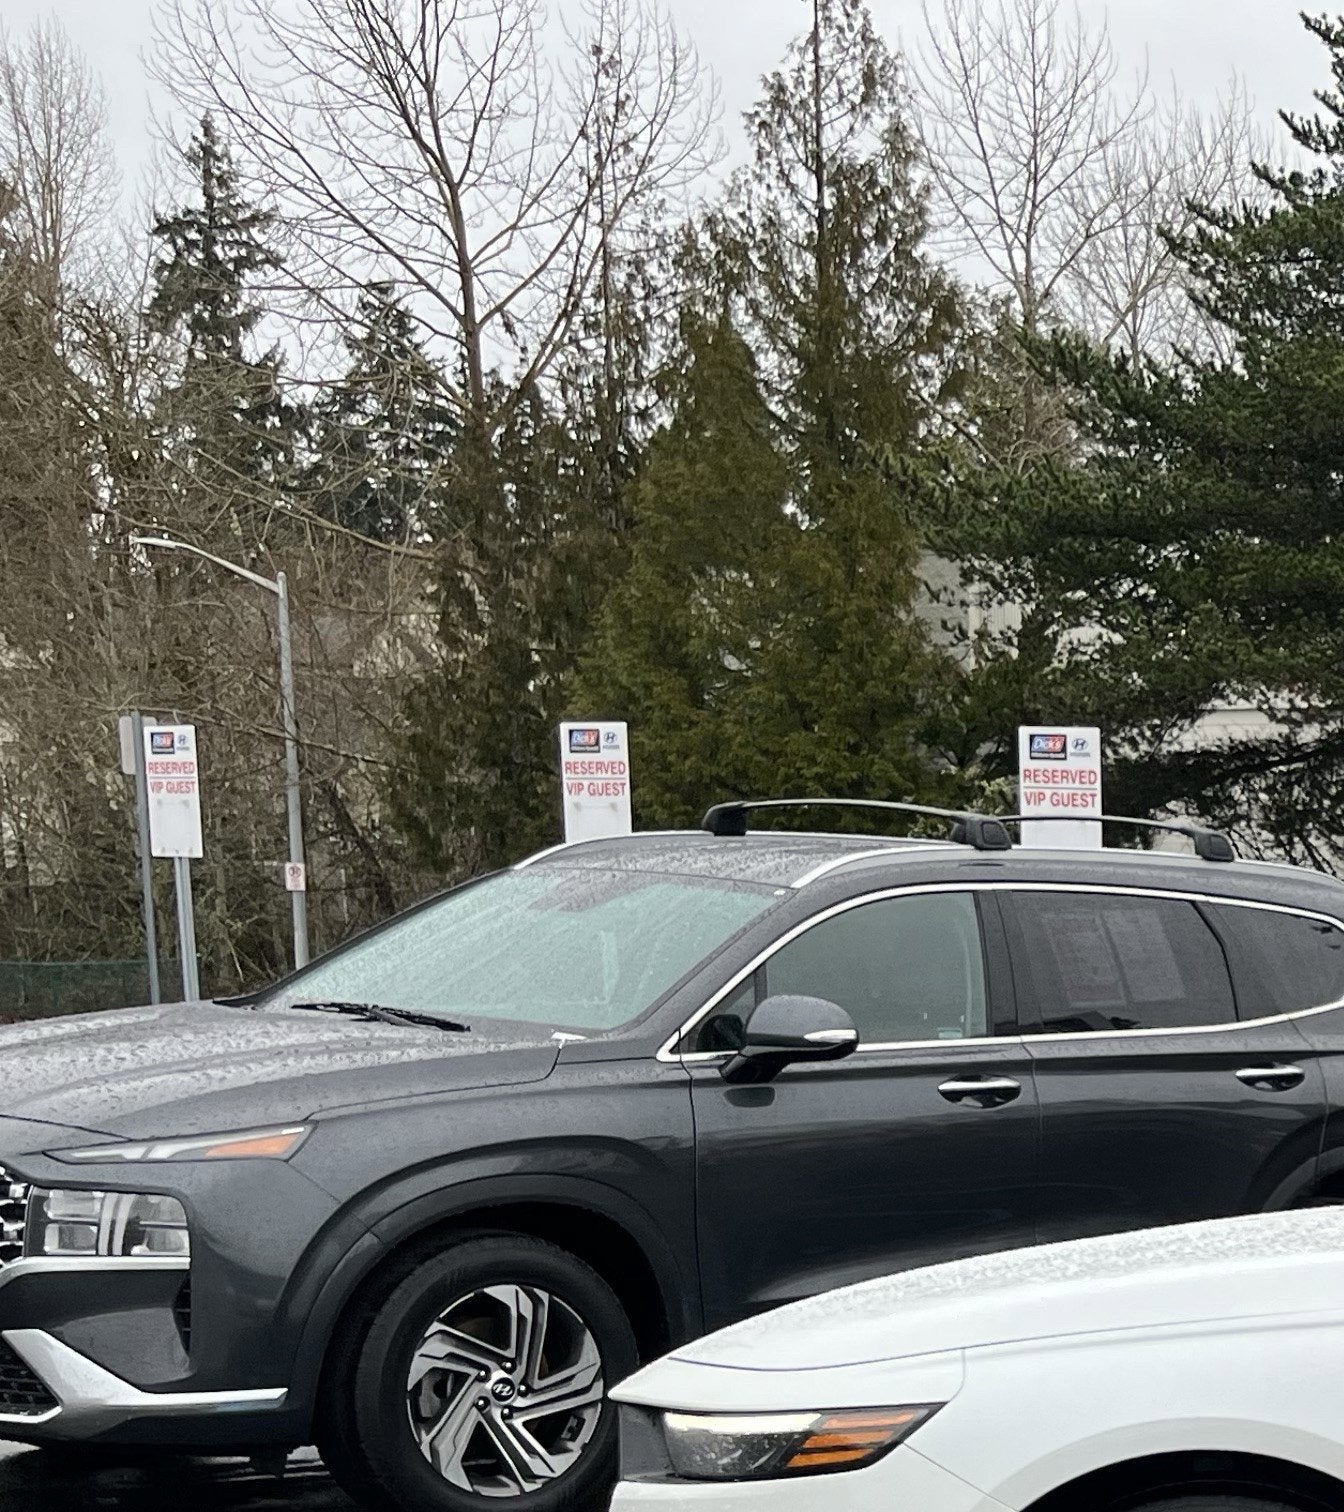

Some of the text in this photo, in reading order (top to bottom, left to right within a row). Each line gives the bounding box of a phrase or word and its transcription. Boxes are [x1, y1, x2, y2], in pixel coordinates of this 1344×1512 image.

[149, 761, 195, 775] RESERVED
[565, 761, 626, 775] RESERVED
[1023, 769, 1098, 785] RESERVED
[150, 781, 196, 794] VIP GUEST
[566, 783, 626, 796] VIP GUEST
[1024, 792, 1098, 808] VIP GUEST
